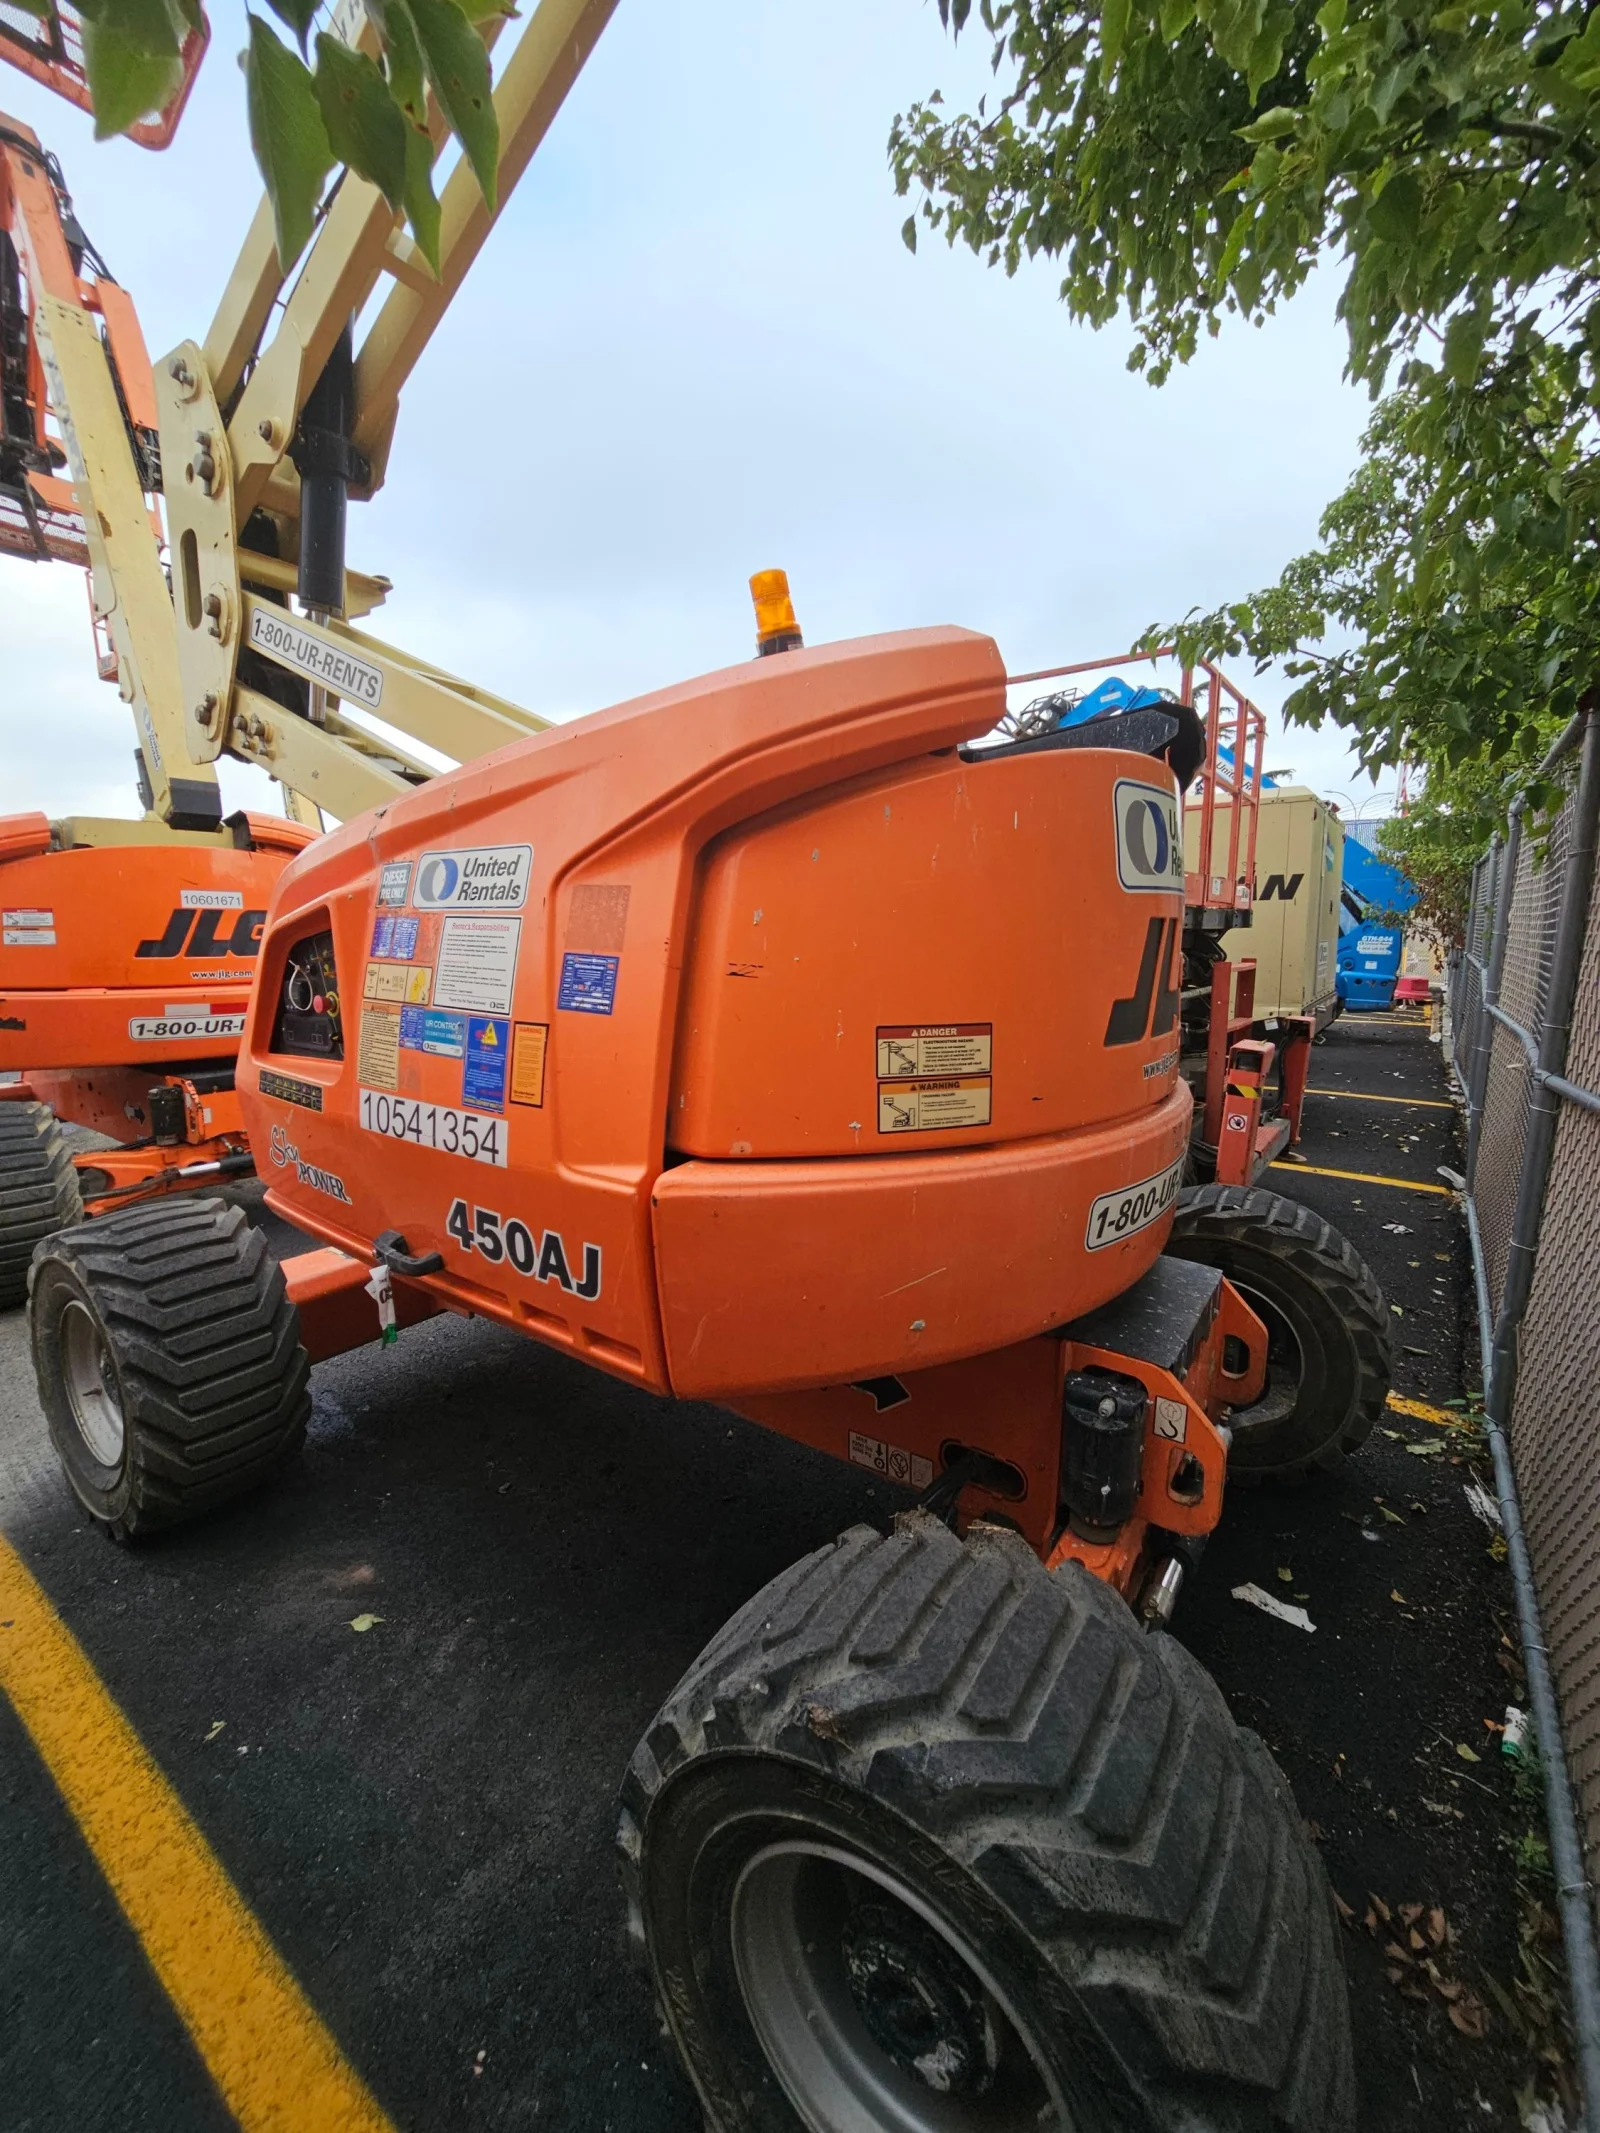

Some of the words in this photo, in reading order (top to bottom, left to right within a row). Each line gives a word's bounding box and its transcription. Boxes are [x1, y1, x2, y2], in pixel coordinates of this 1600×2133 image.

[254, 616, 380, 699] 1-800-UR-RENTS
[383, 870, 407, 885] DIESEL
[463, 854, 521, 878] United
[183, 894, 241, 906] 10601671
[457, 879, 521, 901] Rentals
[134, 908, 267, 957] JLG
[191, 970, 253, 979] www.jlg.com
[1103, 917, 1179, 1047] JL
[920, 1028, 957, 1037] DANGER
[918, 1081, 960, 1091] WARNING
[364, 1092, 500, 1164] 10541354
[1096, 1167, 1180, 1240] 1-800-UR-
[448, 1200, 600, 1300] 450AJ
